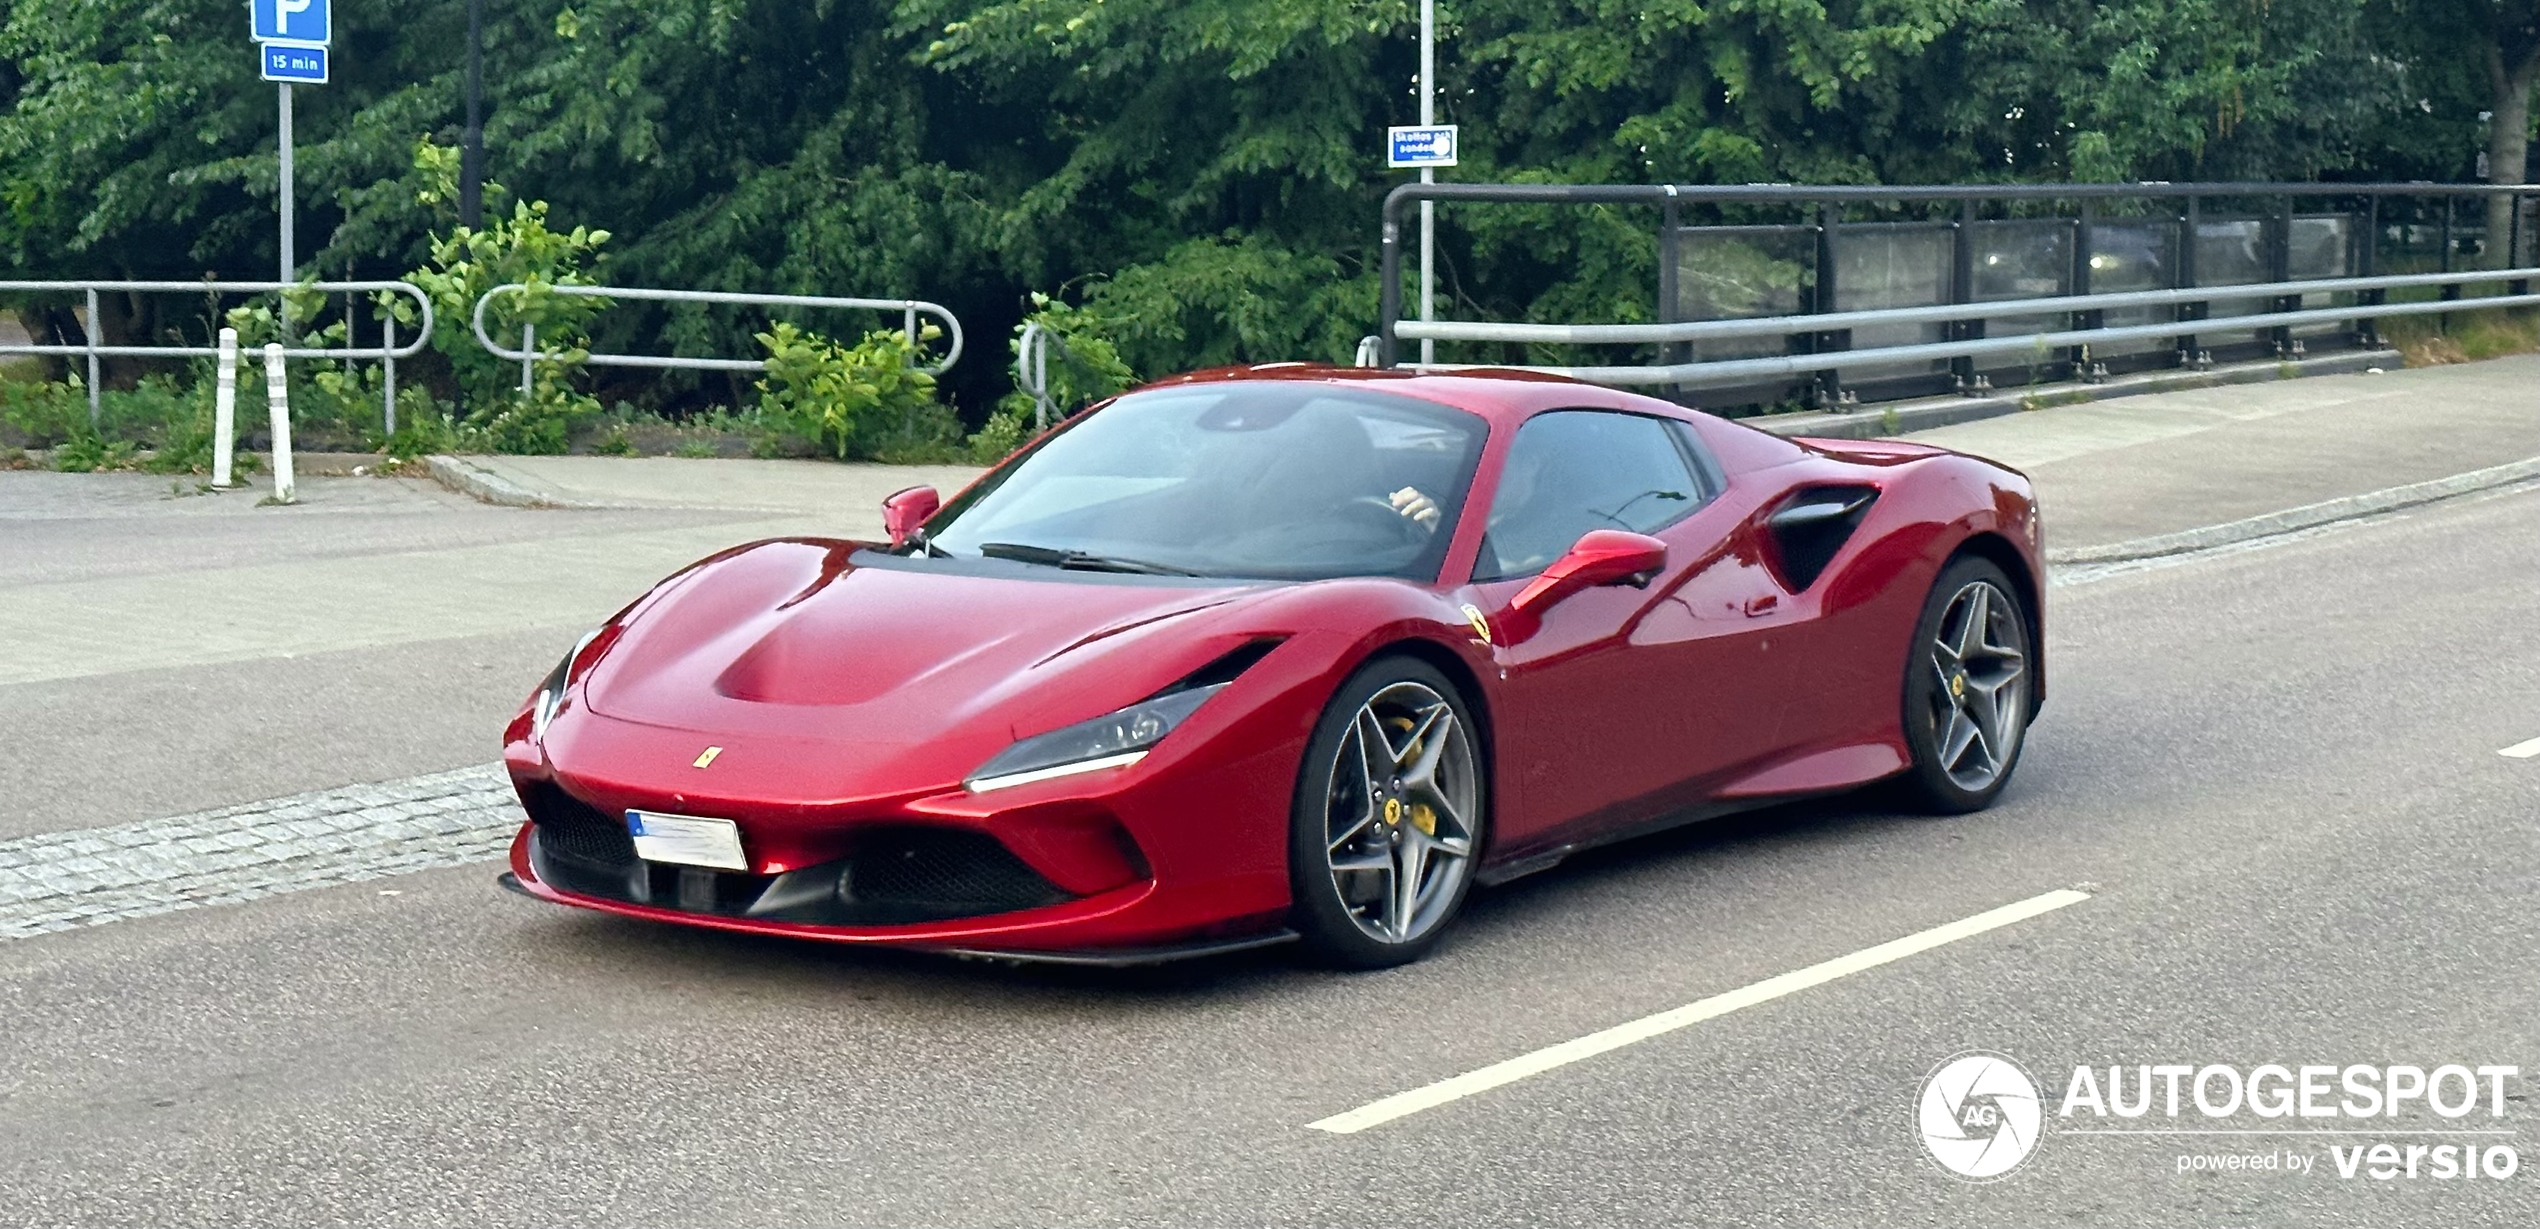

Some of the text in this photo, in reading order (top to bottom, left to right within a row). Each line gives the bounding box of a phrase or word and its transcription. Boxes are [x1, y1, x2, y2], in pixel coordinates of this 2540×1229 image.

[276, 0, 311, 34] P
[272, 55, 318, 70] 15 min
